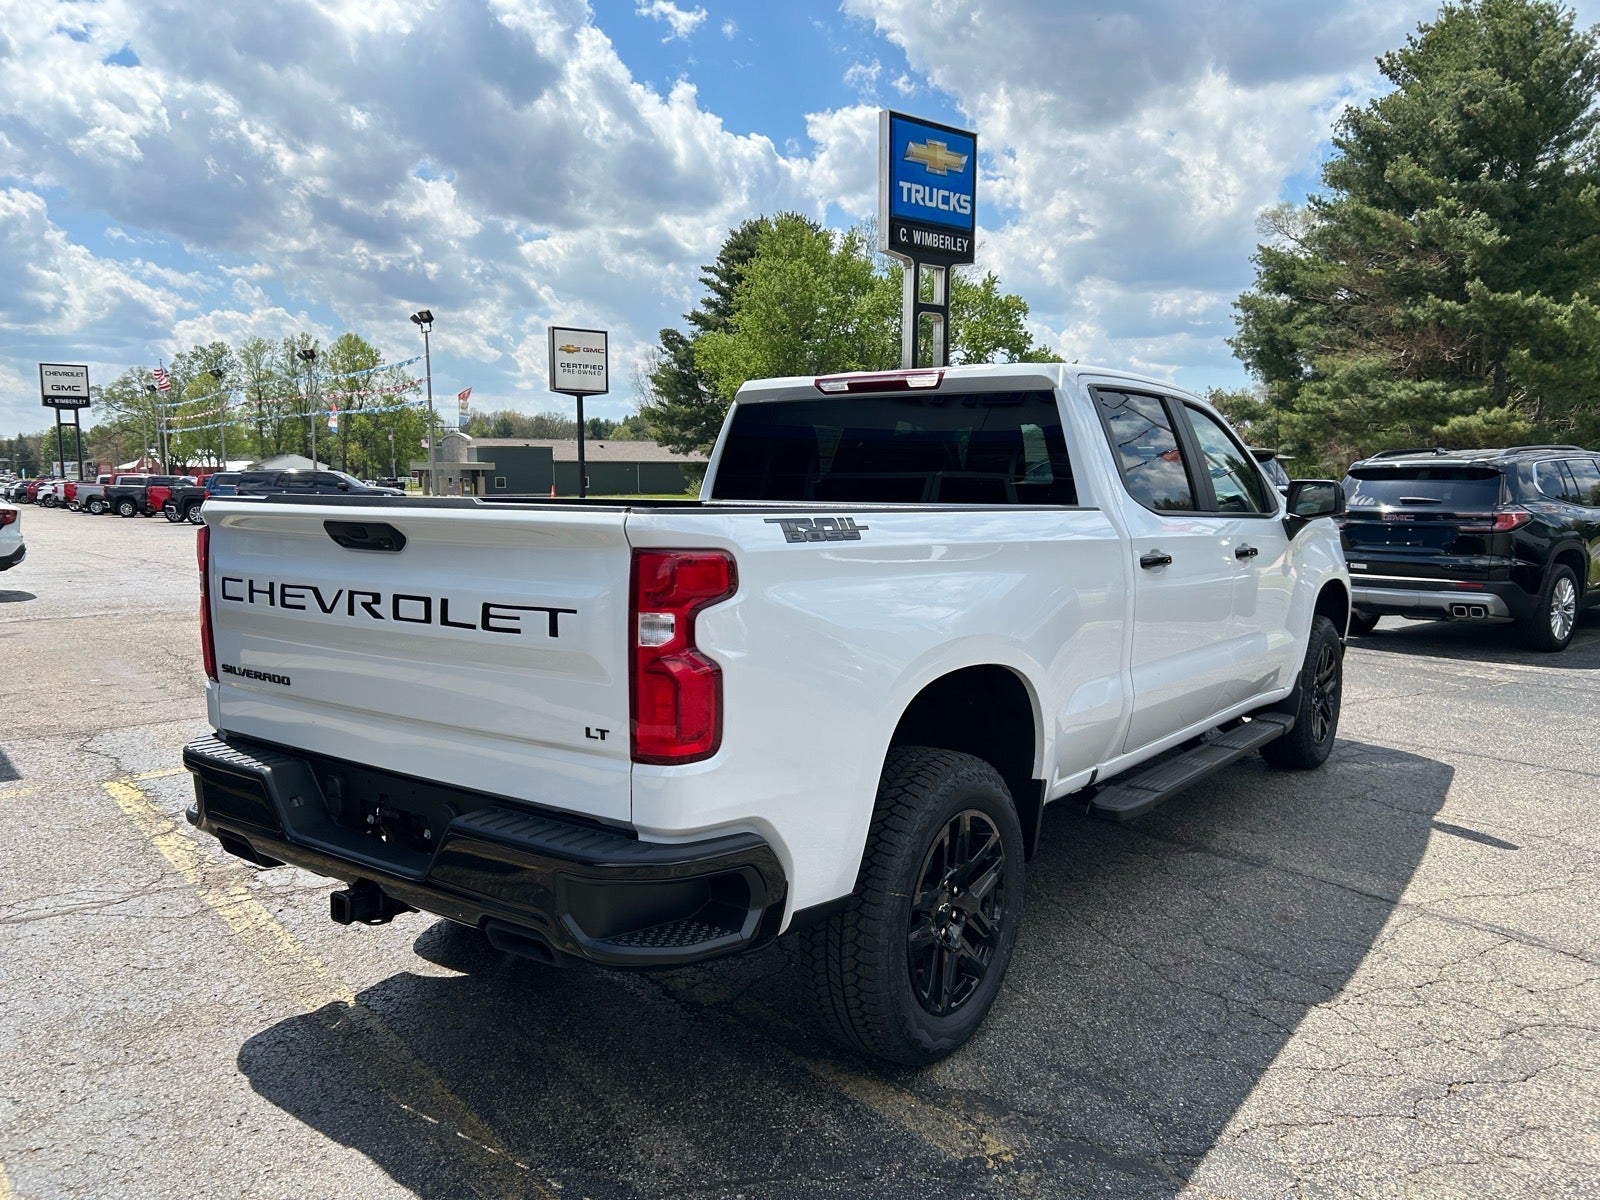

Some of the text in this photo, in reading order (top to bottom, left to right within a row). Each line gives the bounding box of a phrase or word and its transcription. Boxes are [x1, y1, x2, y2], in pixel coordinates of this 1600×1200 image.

[899, 181, 971, 215] TRUCKS
[900, 227, 969, 253] C. WIMBERLEY
[560, 362, 604, 370] CERTIFIED
[562, 368, 602, 376] PRE-OWNED
[763, 517, 869, 531] TRAIL
[785, 530, 862, 543] BOSS
[221, 576, 578, 637] CHEVROLET
[221, 663, 291, 686] SILVERADO
[585, 726, 610, 741] LT
